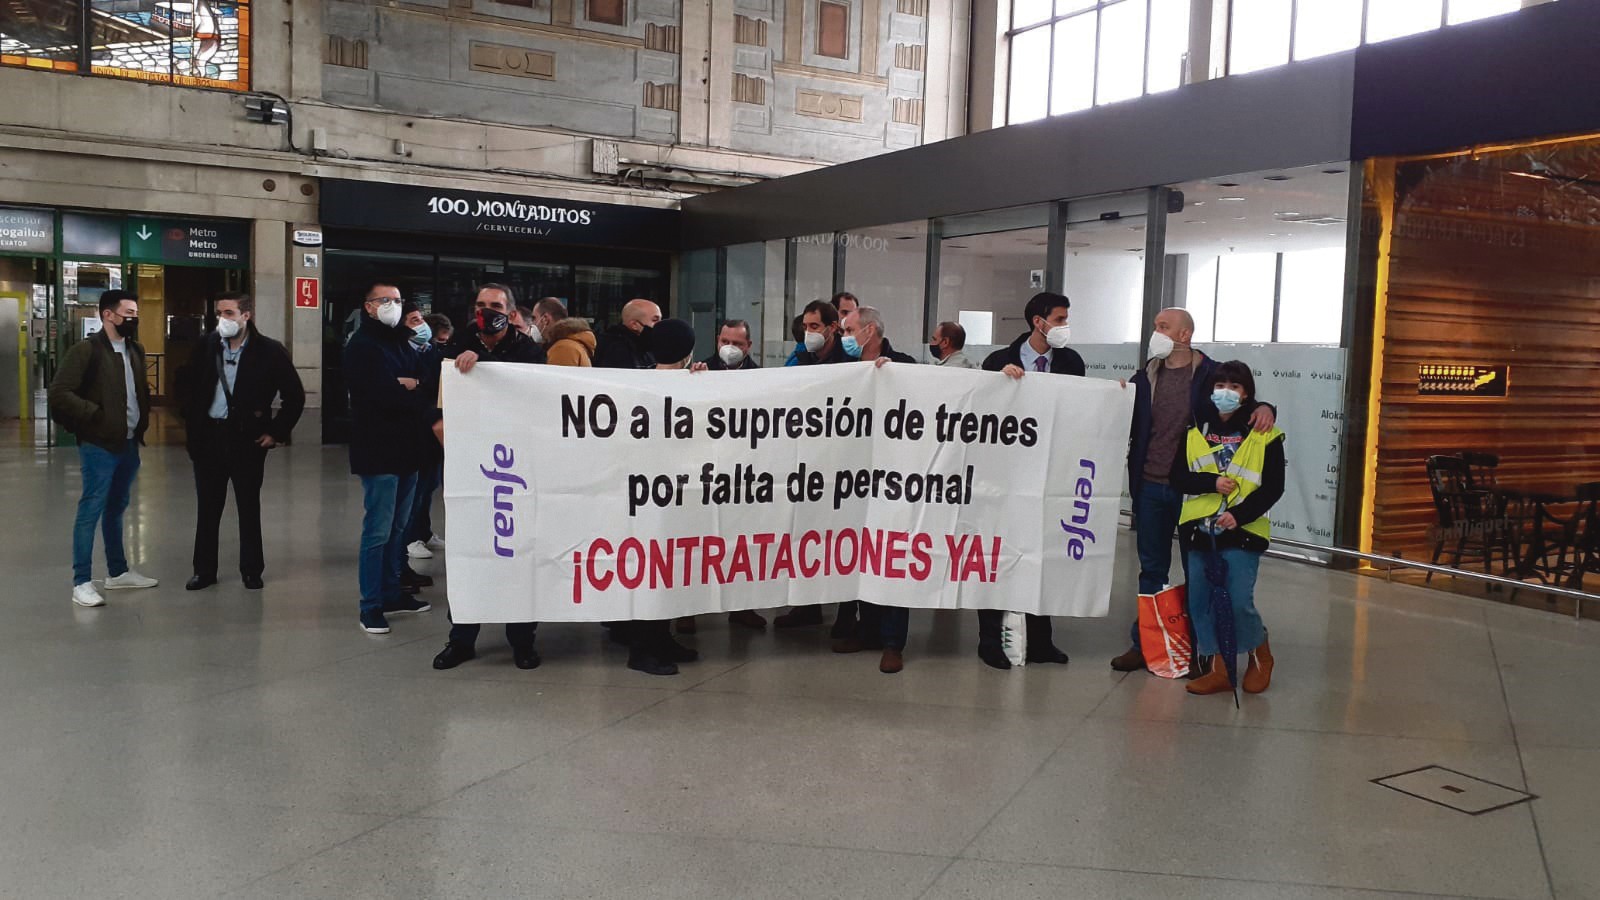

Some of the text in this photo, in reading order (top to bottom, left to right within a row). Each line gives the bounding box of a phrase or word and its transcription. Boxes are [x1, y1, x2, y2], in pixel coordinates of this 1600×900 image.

[427, 196, 591, 225] 100 MONTADITOS
[0, 226, 46, 239] ogailua
[189, 227, 217, 238] Metro
[189, 239, 218, 250] Metro
[188, 251, 238, 260] UNDERGROUND
[1280, 370, 1301, 379] vialia
[1318, 371, 1342, 381] vialia
[561, 394, 1038, 450] NO a la supresión de trenes
[628, 462, 975, 517] por falta de personal
[479, 443, 527, 558] renfe
[1060, 458, 1096, 561] renfe
[1272, 520, 1295, 530] vialia
[573, 527, 1002, 604] ¡CONTRATACIONES YA!
